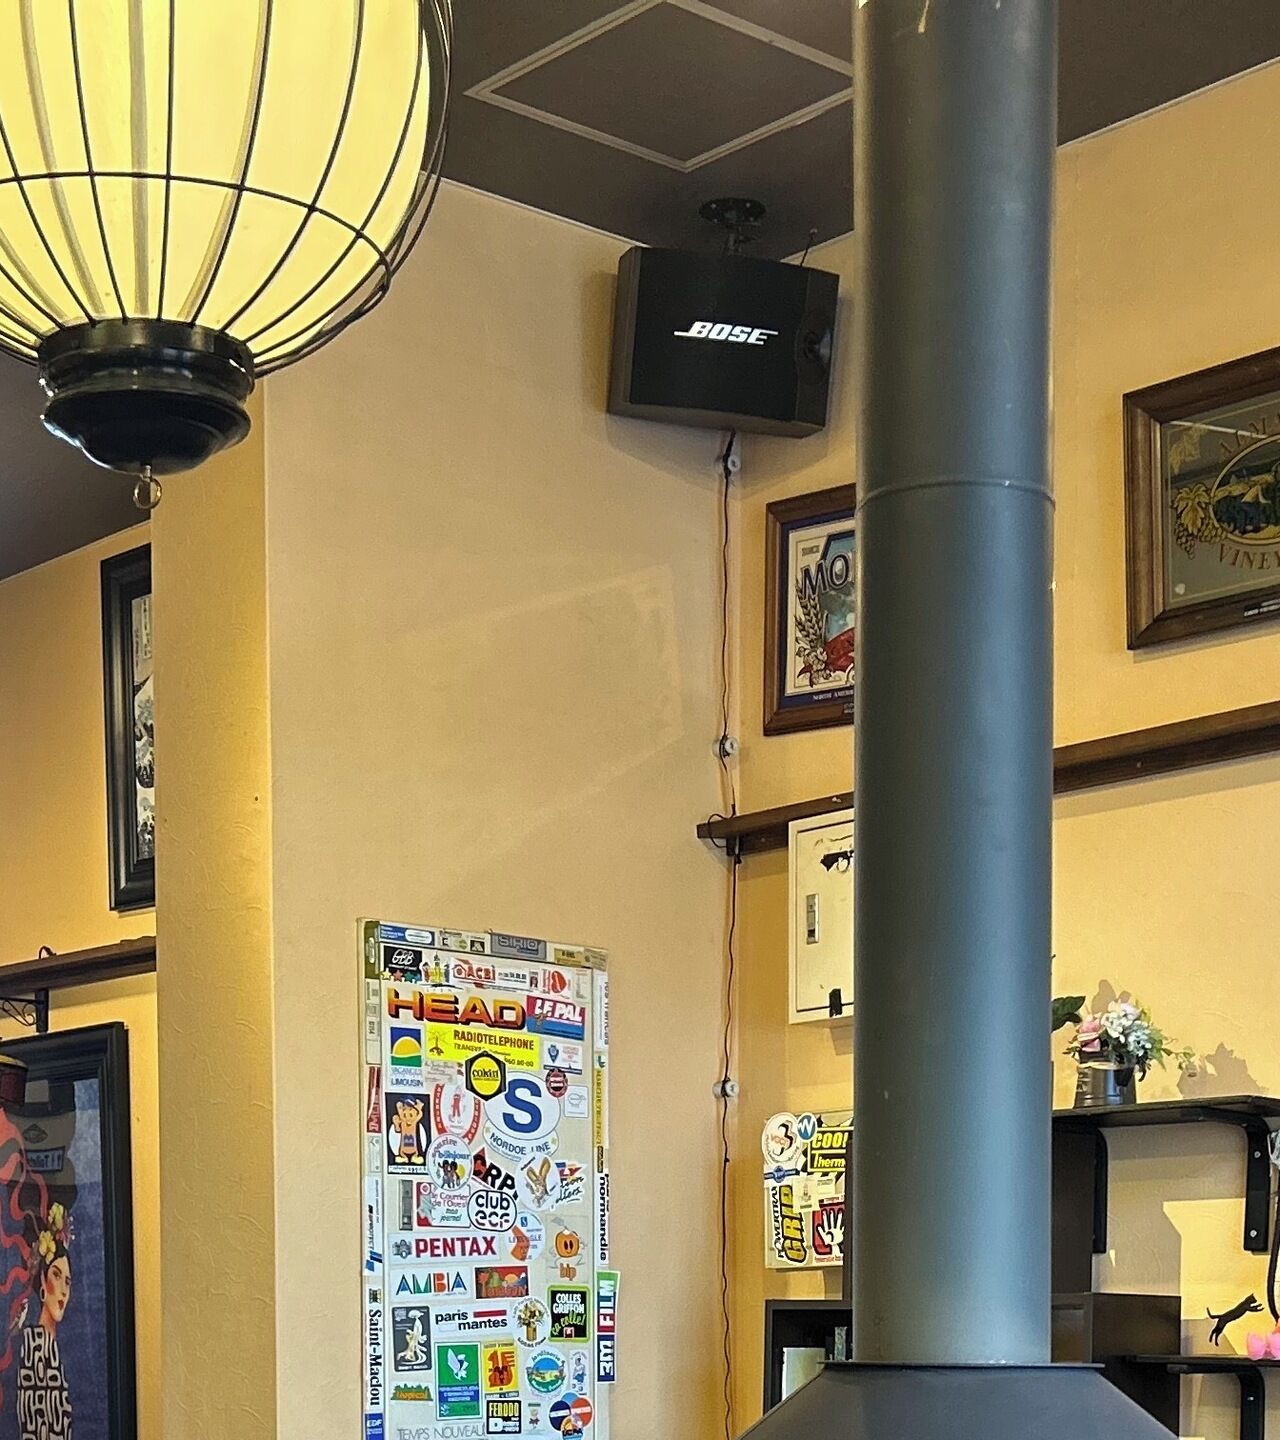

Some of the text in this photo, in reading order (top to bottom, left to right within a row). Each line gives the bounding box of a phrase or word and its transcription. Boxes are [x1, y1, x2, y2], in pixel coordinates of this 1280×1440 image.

[674, 321, 779, 345] BOSE
[800, 552, 854, 601] MO
[387, 987, 527, 1031] HEAD
[453, 1029, 535, 1051] RADIOTELEPHONE
[391, 1078, 424, 1087] LIMOUSIN
[471, 1068, 499, 1078] cokin
[502, 1078, 542, 1134] S
[476, 1190, 511, 1210] club
[599, 1176, 608, 1262] normandie
[414, 1235, 497, 1258] PENTAX
[396, 1271, 467, 1296] AMBIA
[552, 1303, 585, 1314] GRIFFON
[555, 1293, 582, 1304] COLLES
[435, 1309, 469, 1325] paris
[458, 1317, 508, 1331] mantes
[599, 1279, 615, 1376] 3M FILM
[369, 1309, 383, 1406] Saint-Maclou
[488, 1402, 520, 1417] FERODO
[397, 1427, 430, 1440] TEMPS
